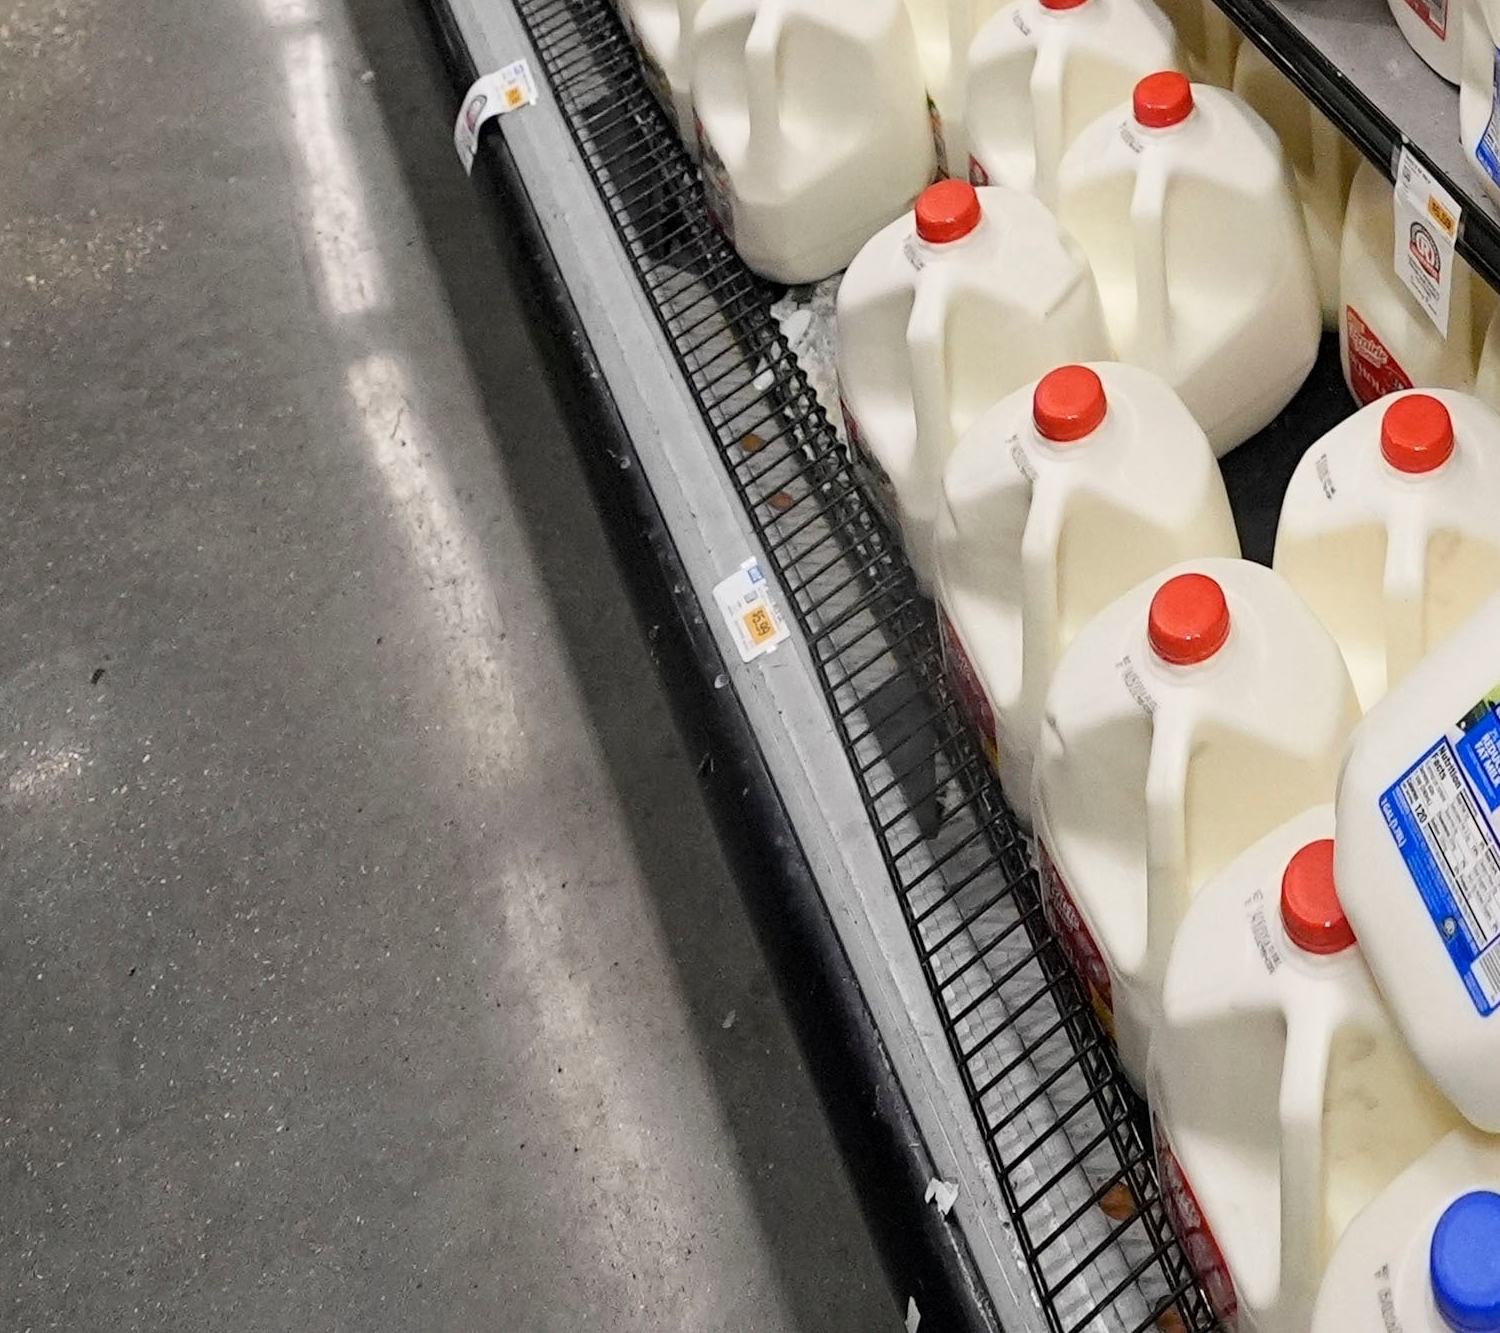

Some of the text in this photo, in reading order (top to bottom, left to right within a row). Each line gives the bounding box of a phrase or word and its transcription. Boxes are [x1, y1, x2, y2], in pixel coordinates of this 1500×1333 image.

[1432, 752, 1448, 781] Facts
[1437, 743, 1463, 790] Nutrition
[1474, 742, 1489, 765] FAT
[1414, 803, 1429, 825] 120
